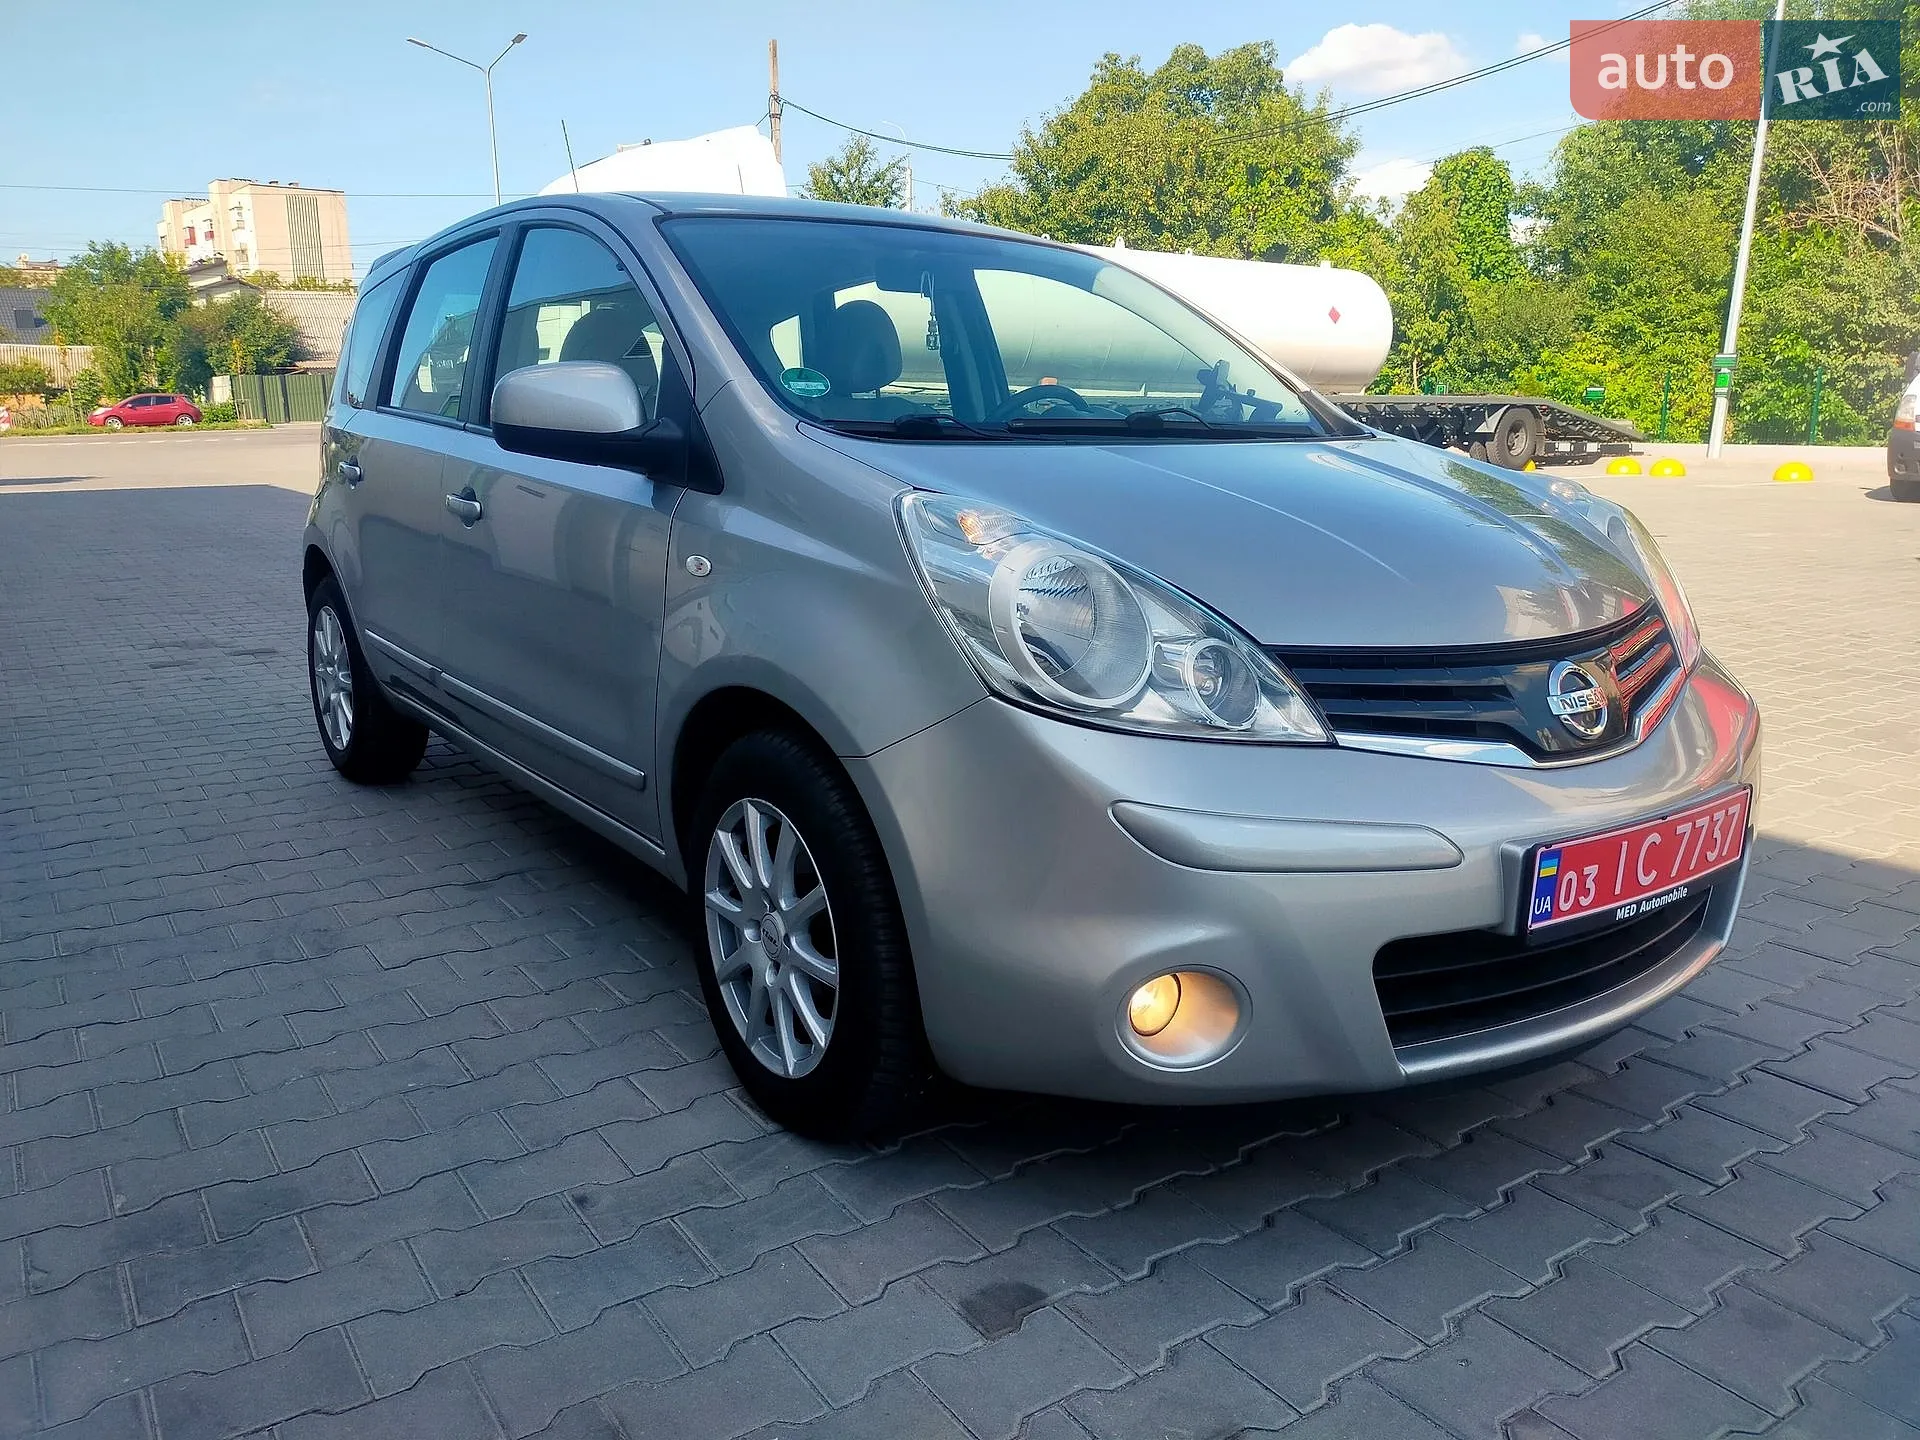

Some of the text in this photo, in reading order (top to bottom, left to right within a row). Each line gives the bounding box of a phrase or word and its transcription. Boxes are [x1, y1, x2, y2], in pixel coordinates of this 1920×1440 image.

[1558, 803, 1741, 912] 03 IC 7737
[1534, 895, 1551, 915] UA
[1616, 886, 1688, 921] MED Automobile
